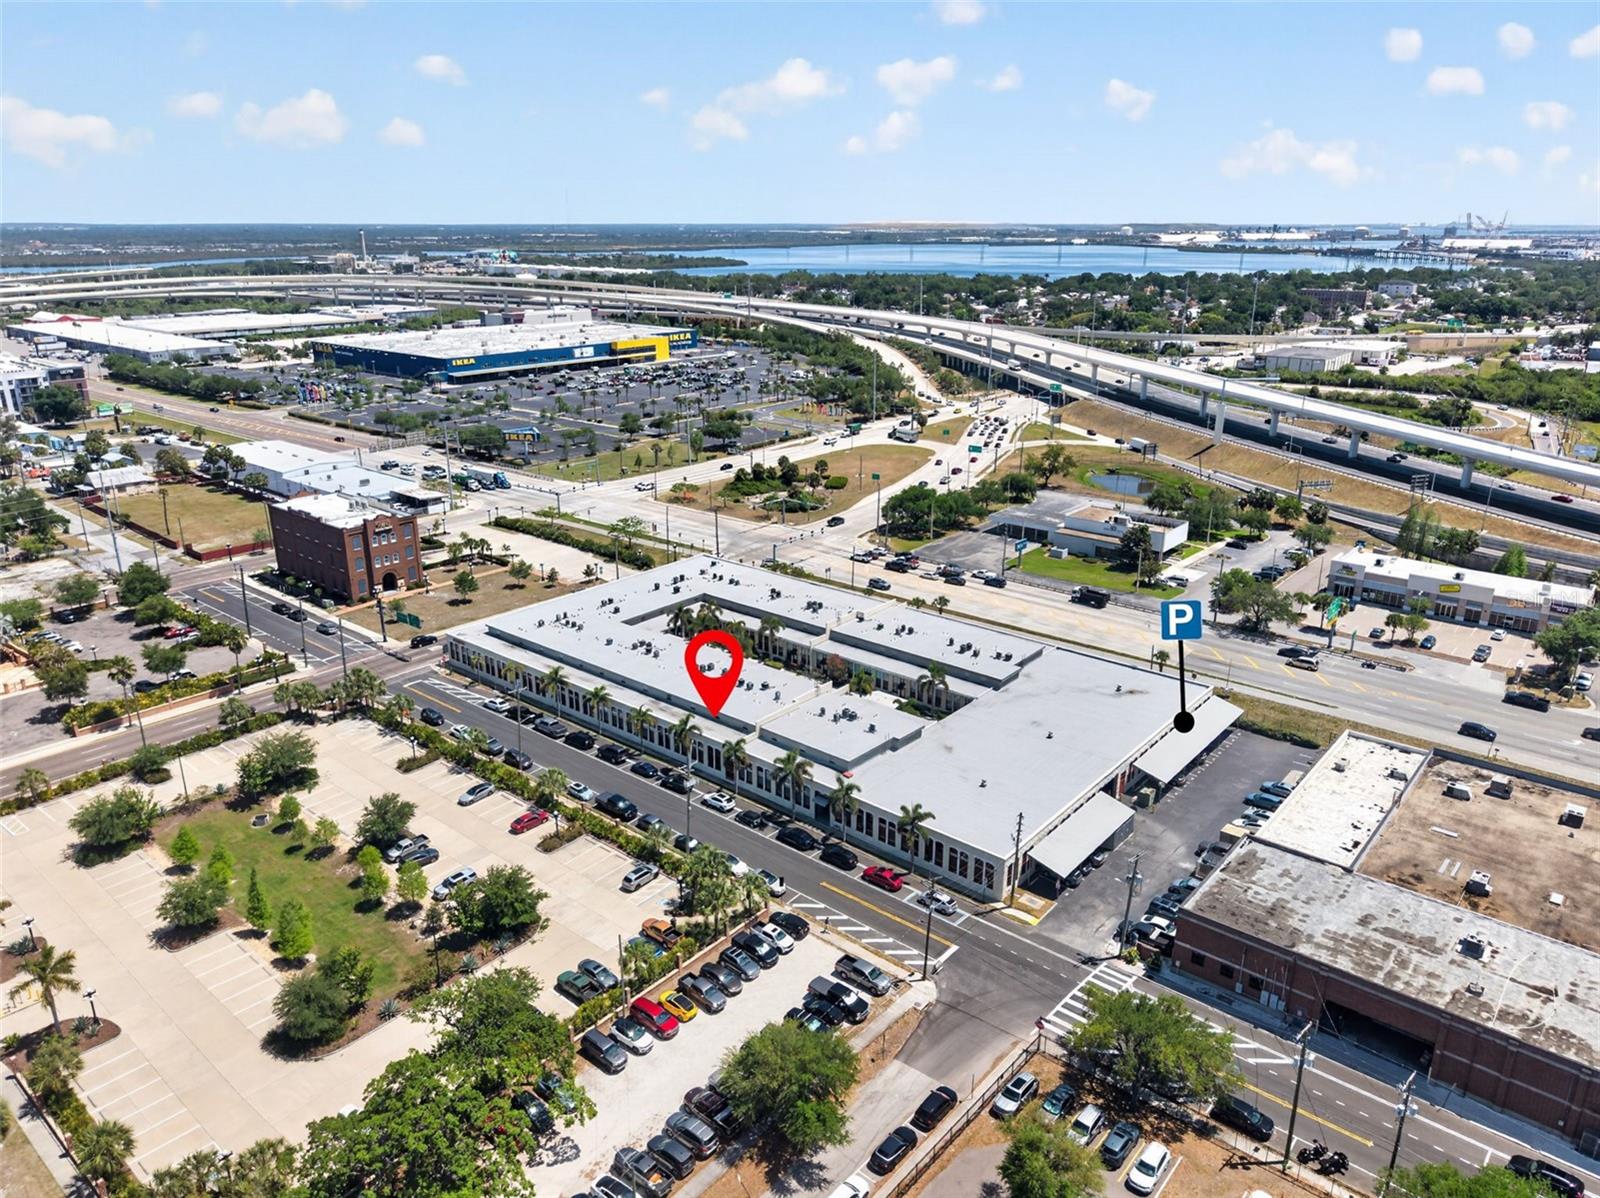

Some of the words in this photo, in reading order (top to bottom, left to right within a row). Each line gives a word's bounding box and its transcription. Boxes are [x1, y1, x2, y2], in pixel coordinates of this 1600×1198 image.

[669, 332, 692, 341] IKEA
[451, 358, 476, 366] IKEA
[505, 433, 533, 441] IKEA
